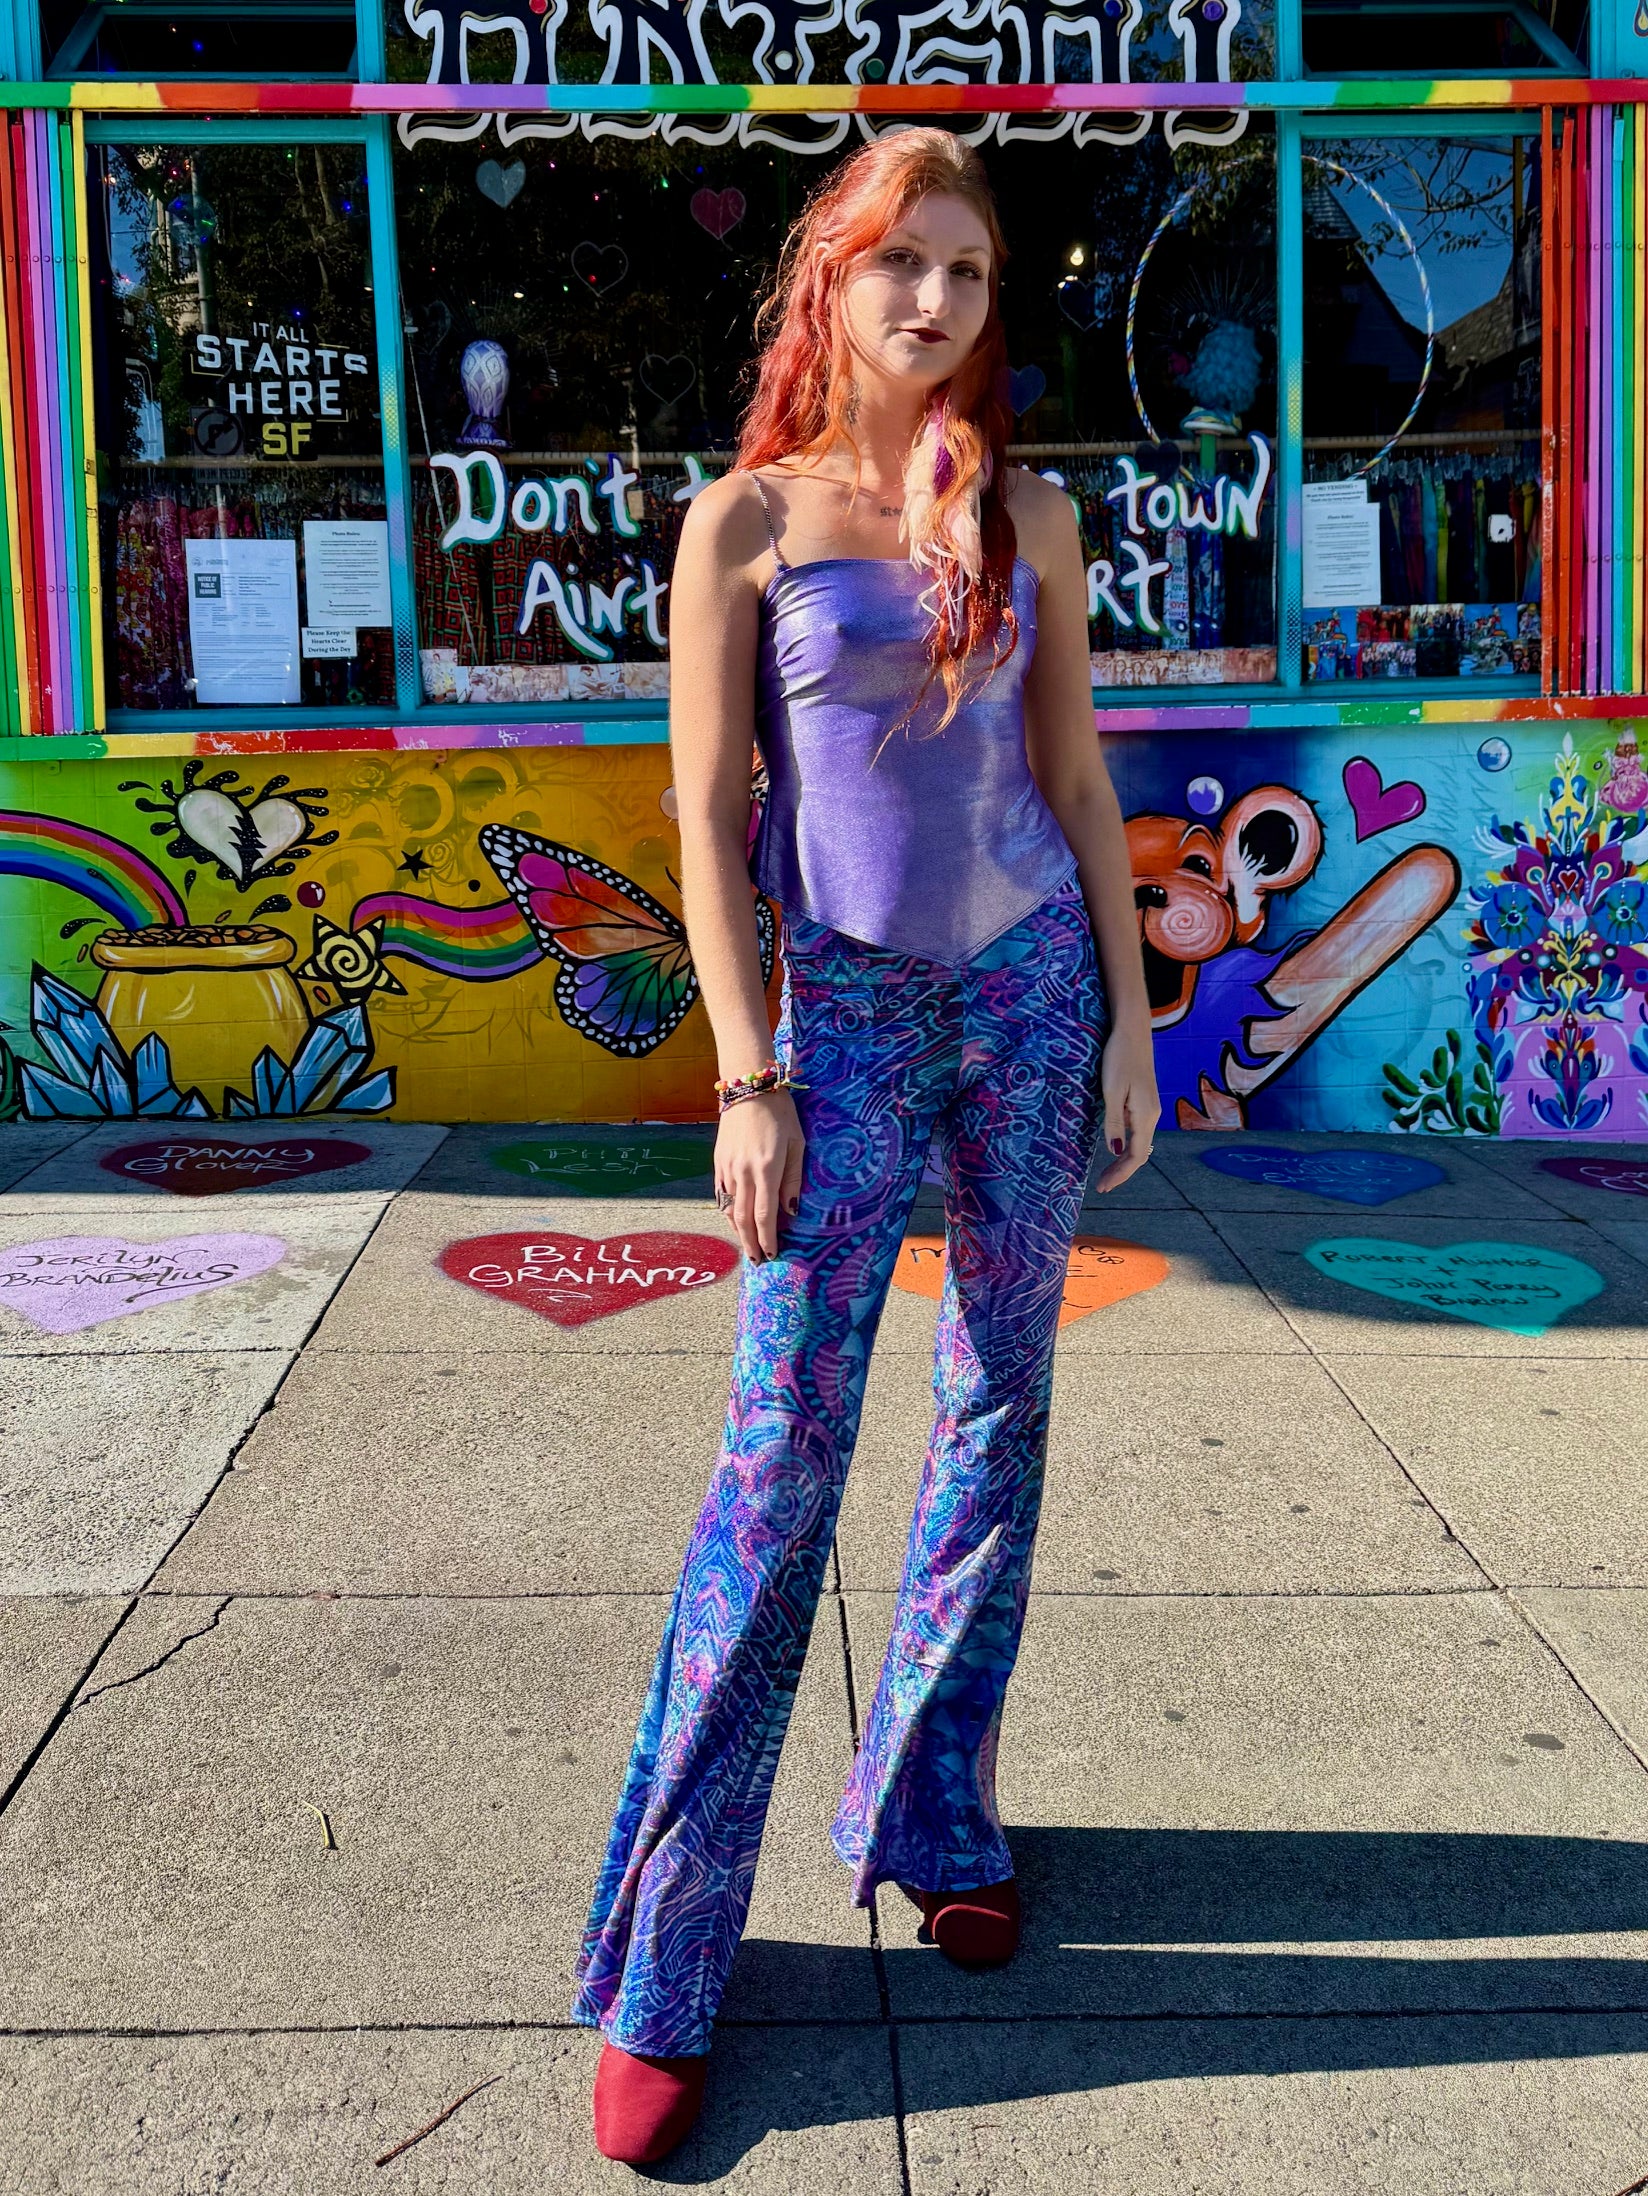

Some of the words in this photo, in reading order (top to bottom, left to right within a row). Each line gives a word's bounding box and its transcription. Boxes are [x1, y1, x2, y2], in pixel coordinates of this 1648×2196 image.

[252, 321, 270, 338] IT
[276, 326, 310, 343] ALL
[196, 333, 369, 376] STARTS
[228, 379, 343, 416] HERE
[261, 422, 313, 456] SF
[427, 447, 642, 554] Don't
